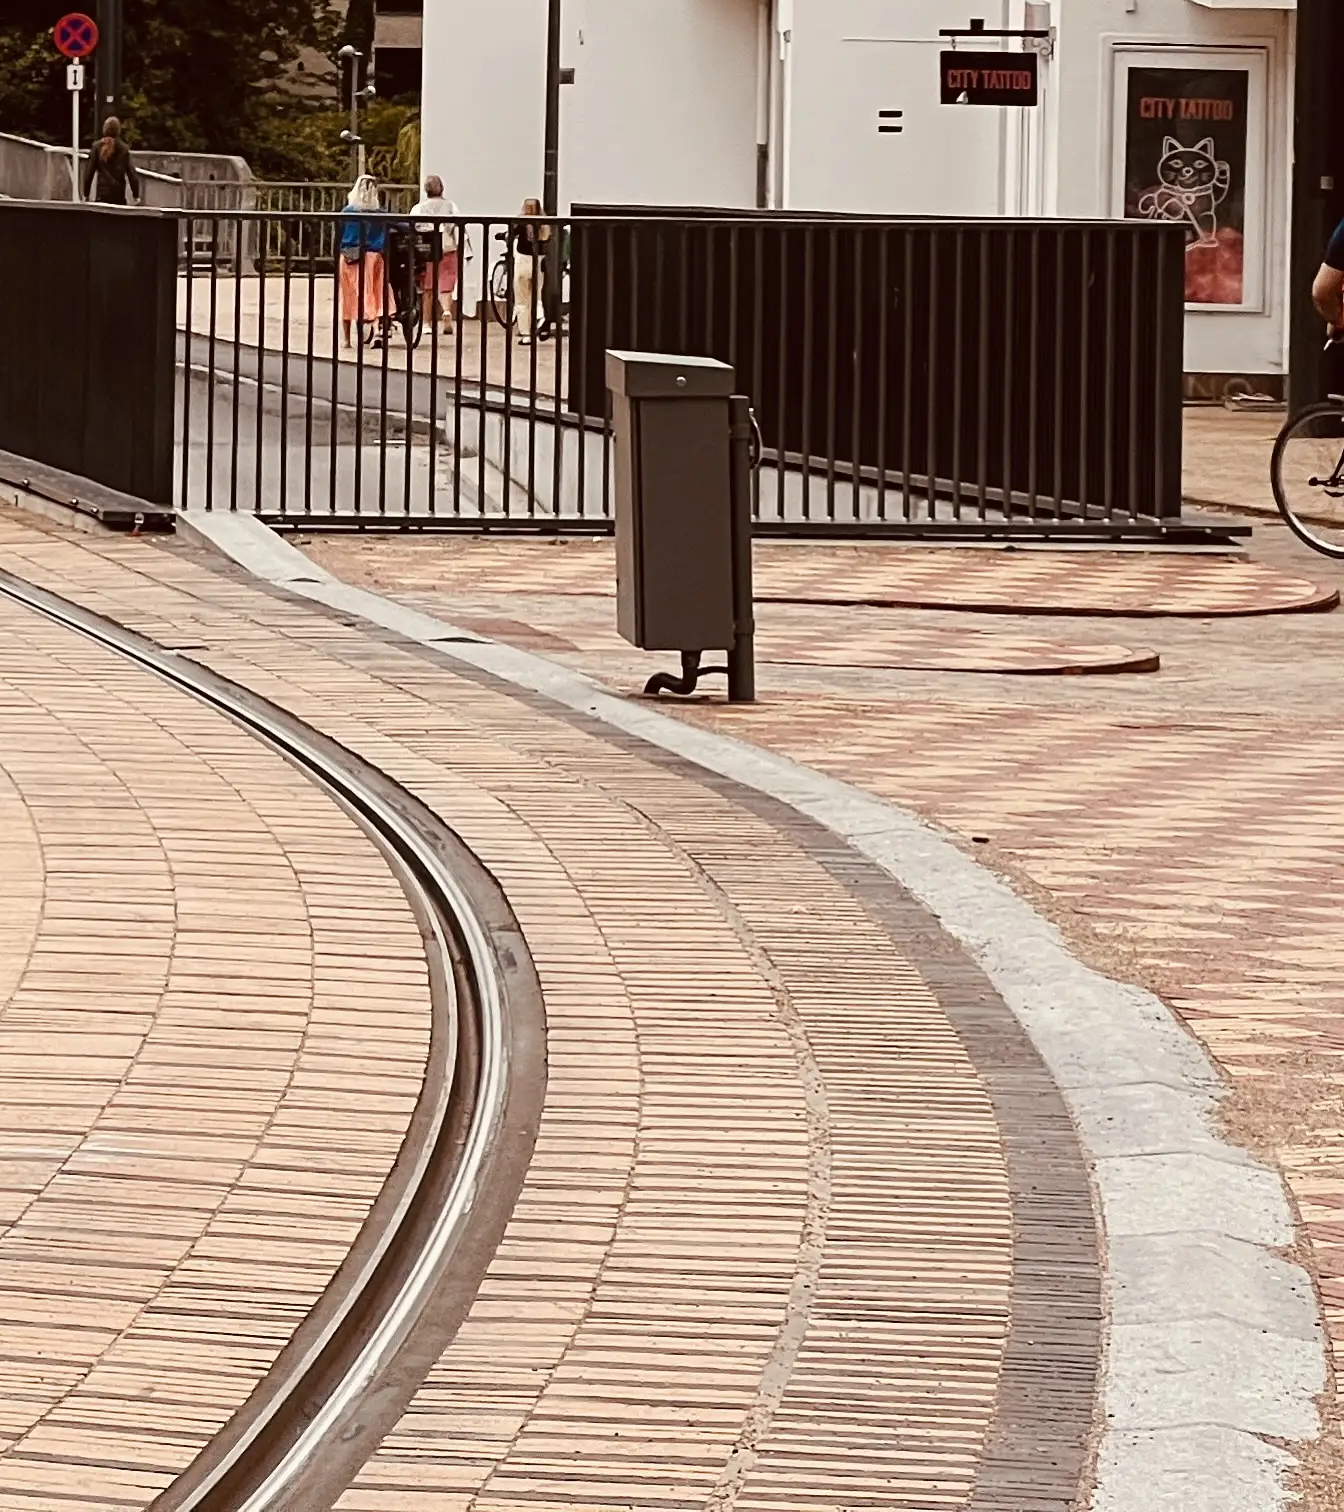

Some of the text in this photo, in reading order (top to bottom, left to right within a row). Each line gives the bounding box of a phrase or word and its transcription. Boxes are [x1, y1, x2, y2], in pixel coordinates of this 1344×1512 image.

[947, 69, 1031, 90] CITY TATTOO
[1140, 97, 1232, 120] CITY TATTOO
